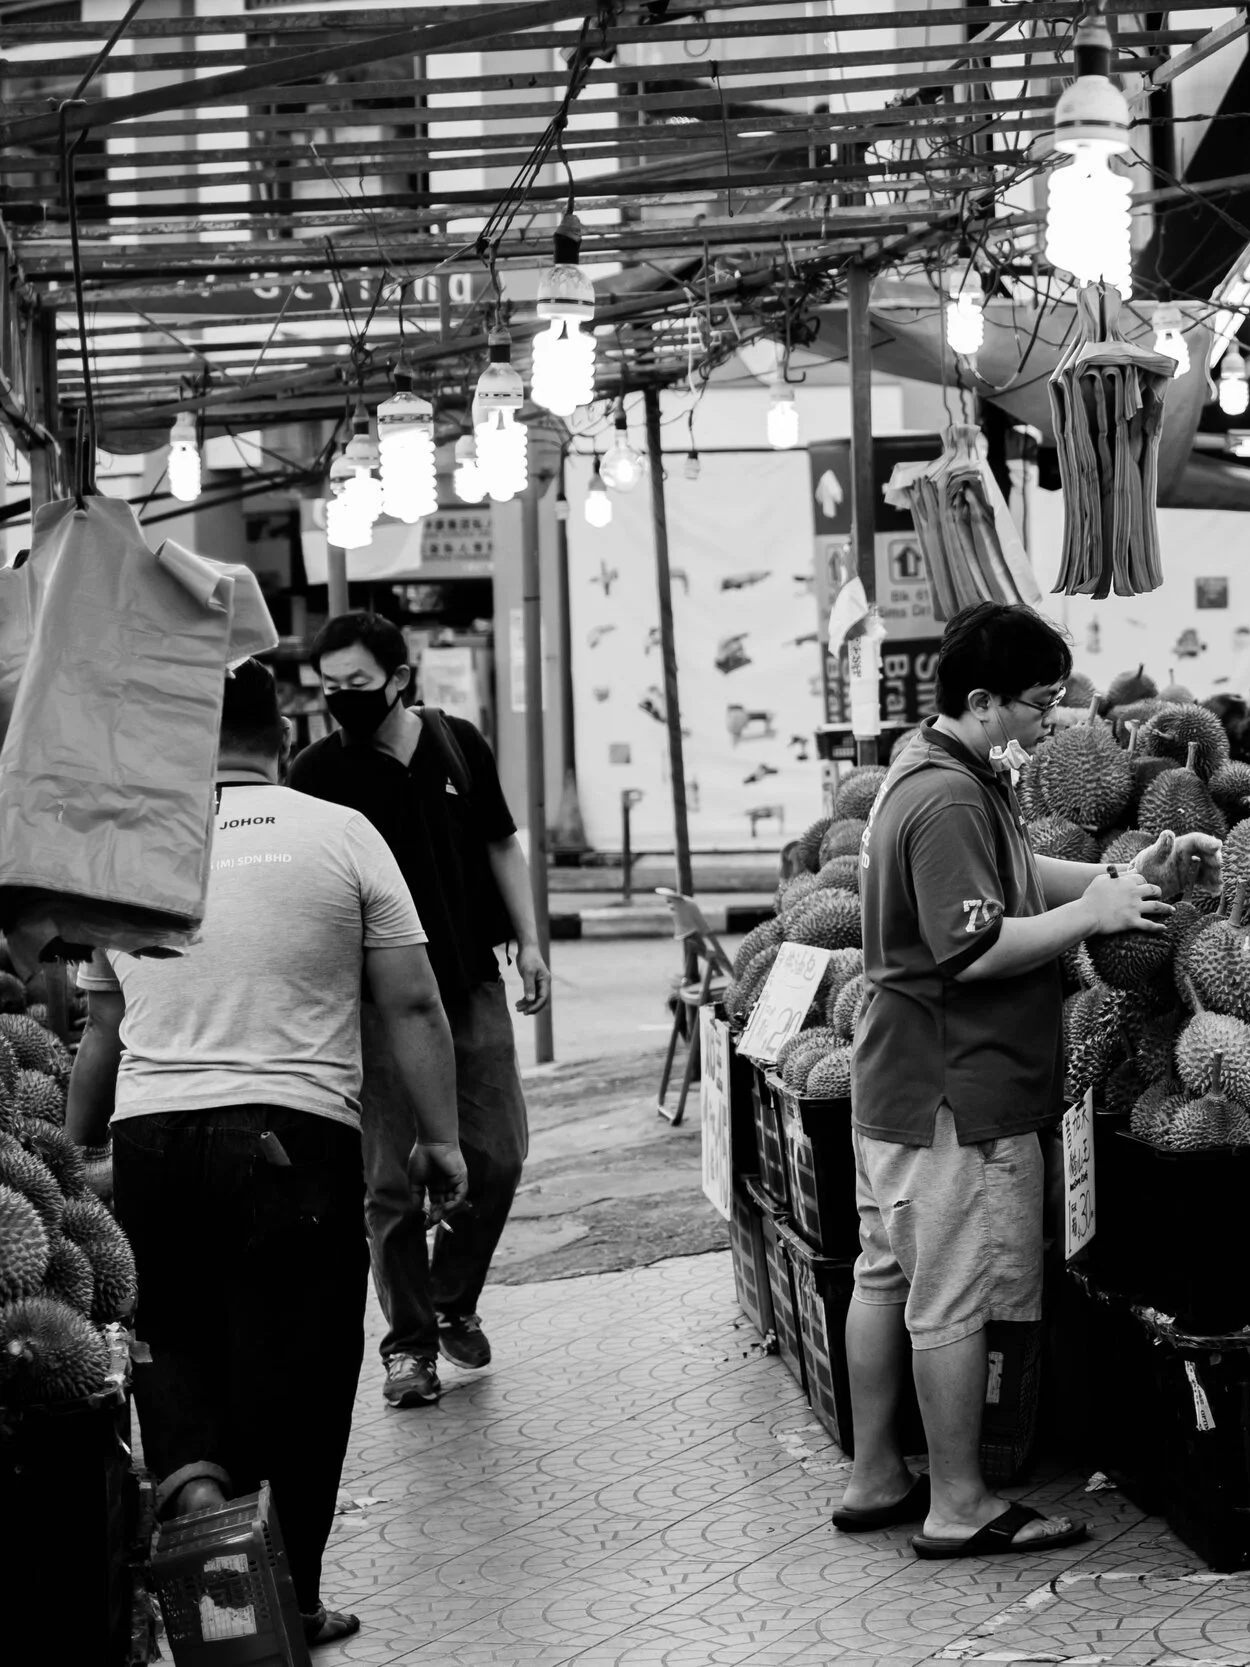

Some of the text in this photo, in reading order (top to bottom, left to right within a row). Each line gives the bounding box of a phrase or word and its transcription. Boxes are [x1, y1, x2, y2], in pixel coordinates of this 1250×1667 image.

[219, 816, 276, 830] JOHOR
[238, 854, 262, 867] SDN
[264, 853, 292, 863] BHD
